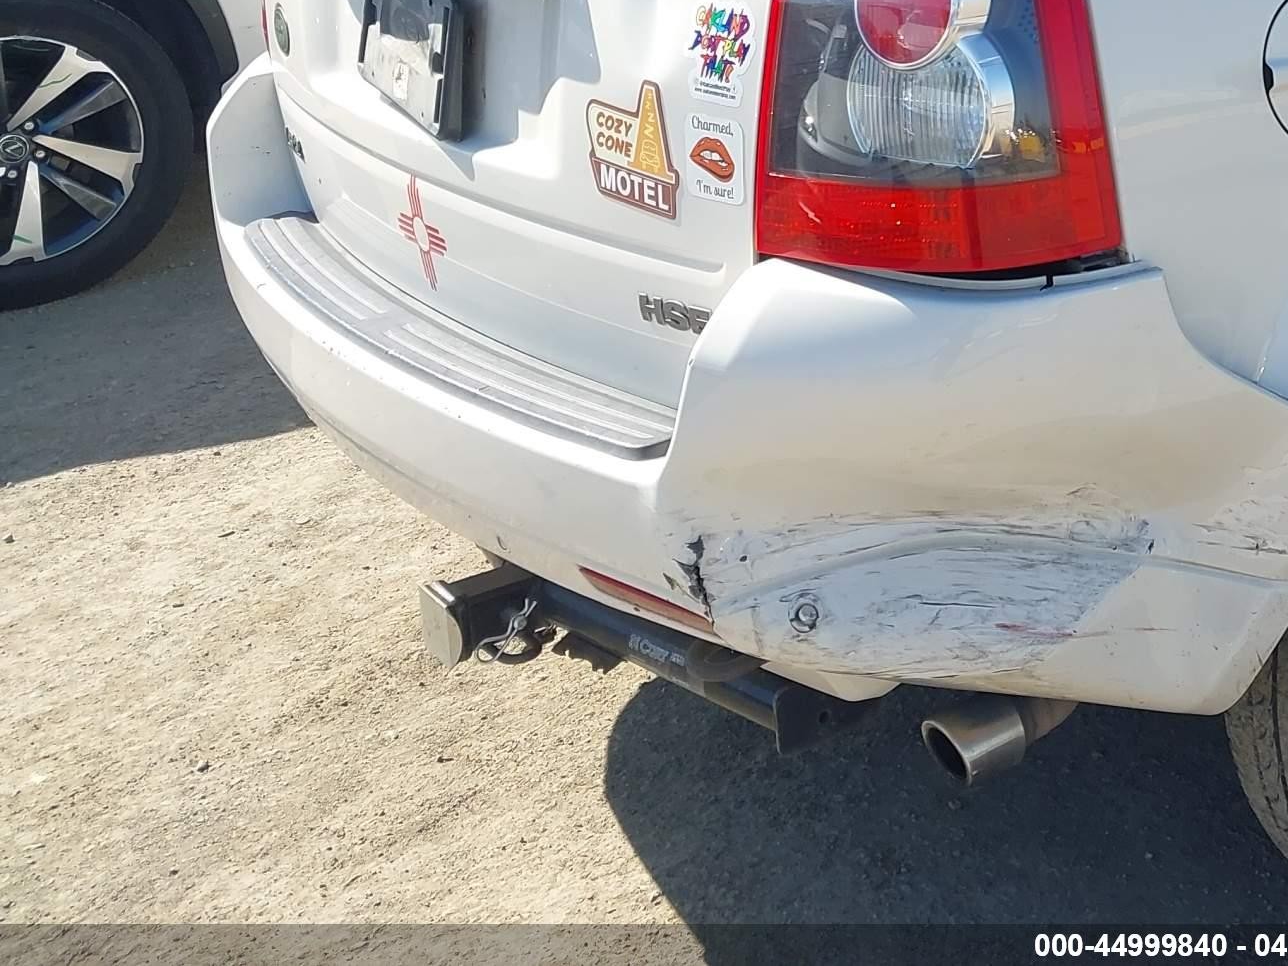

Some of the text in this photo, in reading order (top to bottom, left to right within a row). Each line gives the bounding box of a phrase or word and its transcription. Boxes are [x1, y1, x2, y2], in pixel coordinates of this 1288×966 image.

[596, 111, 633, 137] COZY
[691, 115, 734, 136] Charmed,
[596, 131, 634, 158] CONE
[600, 164, 670, 211] MOTEL
[713, 185, 735, 200] sure!
